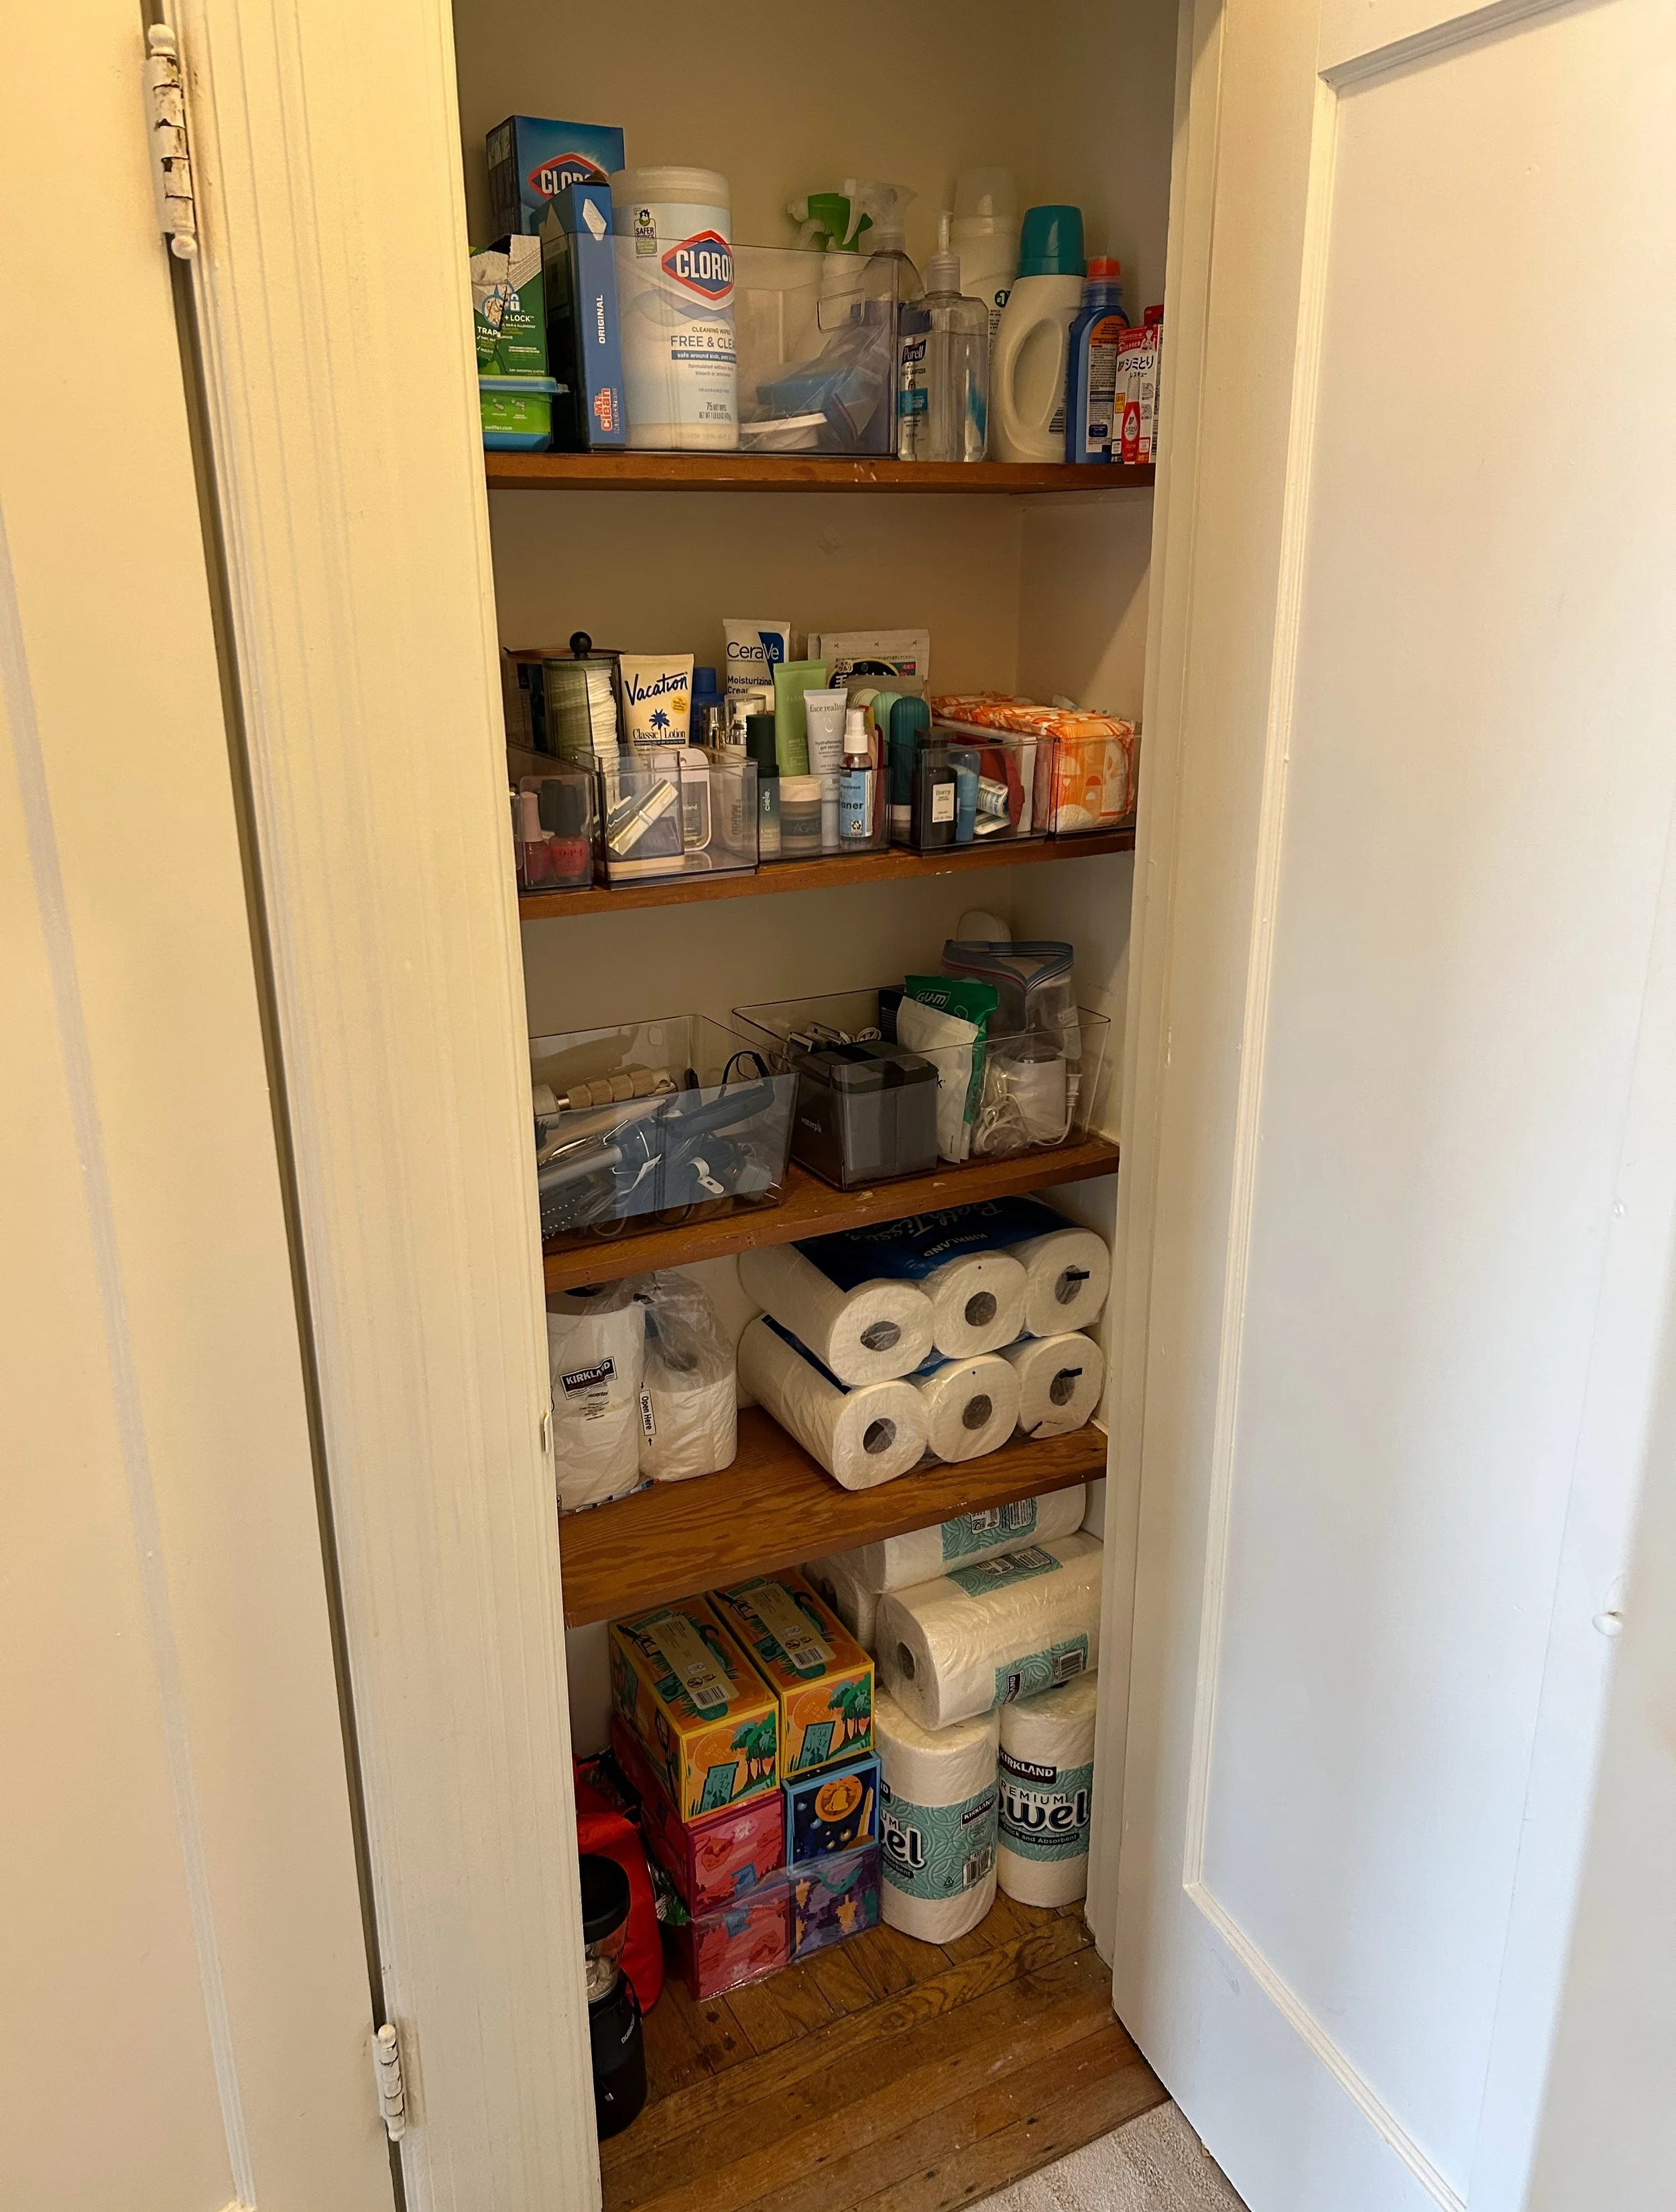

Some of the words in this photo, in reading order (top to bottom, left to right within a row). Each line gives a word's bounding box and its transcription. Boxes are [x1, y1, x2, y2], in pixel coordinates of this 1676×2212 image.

[676, 249, 734, 282] CLOROX
[596, 294, 606, 344] ORIGINAL
[477, 326, 497, 336] TRAP
[670, 335, 704, 347] FREE
[707, 337, 715, 347] &
[717, 337, 735, 349] CLEA
[904, 344, 924, 361] Purell
[1125, 355, 1154, 371] シミとり
[601, 388, 613, 431] Clean
[706, 402, 713, 411] 75
[727, 642, 779, 660] CeraVe
[810, 703, 823, 713] face
[824, 703, 845, 713] reality
[632, 727, 658, 740] Classic
[663, 727, 686, 739] Lotion
[923, 1233, 988, 1257] KIRKLAND
[641, 1395, 649, 1413] Open
[1000, 1751, 1054, 1778] KIRKLAND
[1001, 1779, 1064, 1805] REMIUM
[999, 1788, 1089, 1831] wel
[1021, 1832, 1036, 1843] and
[1038, 1833, 1077, 1844] Absorbent
